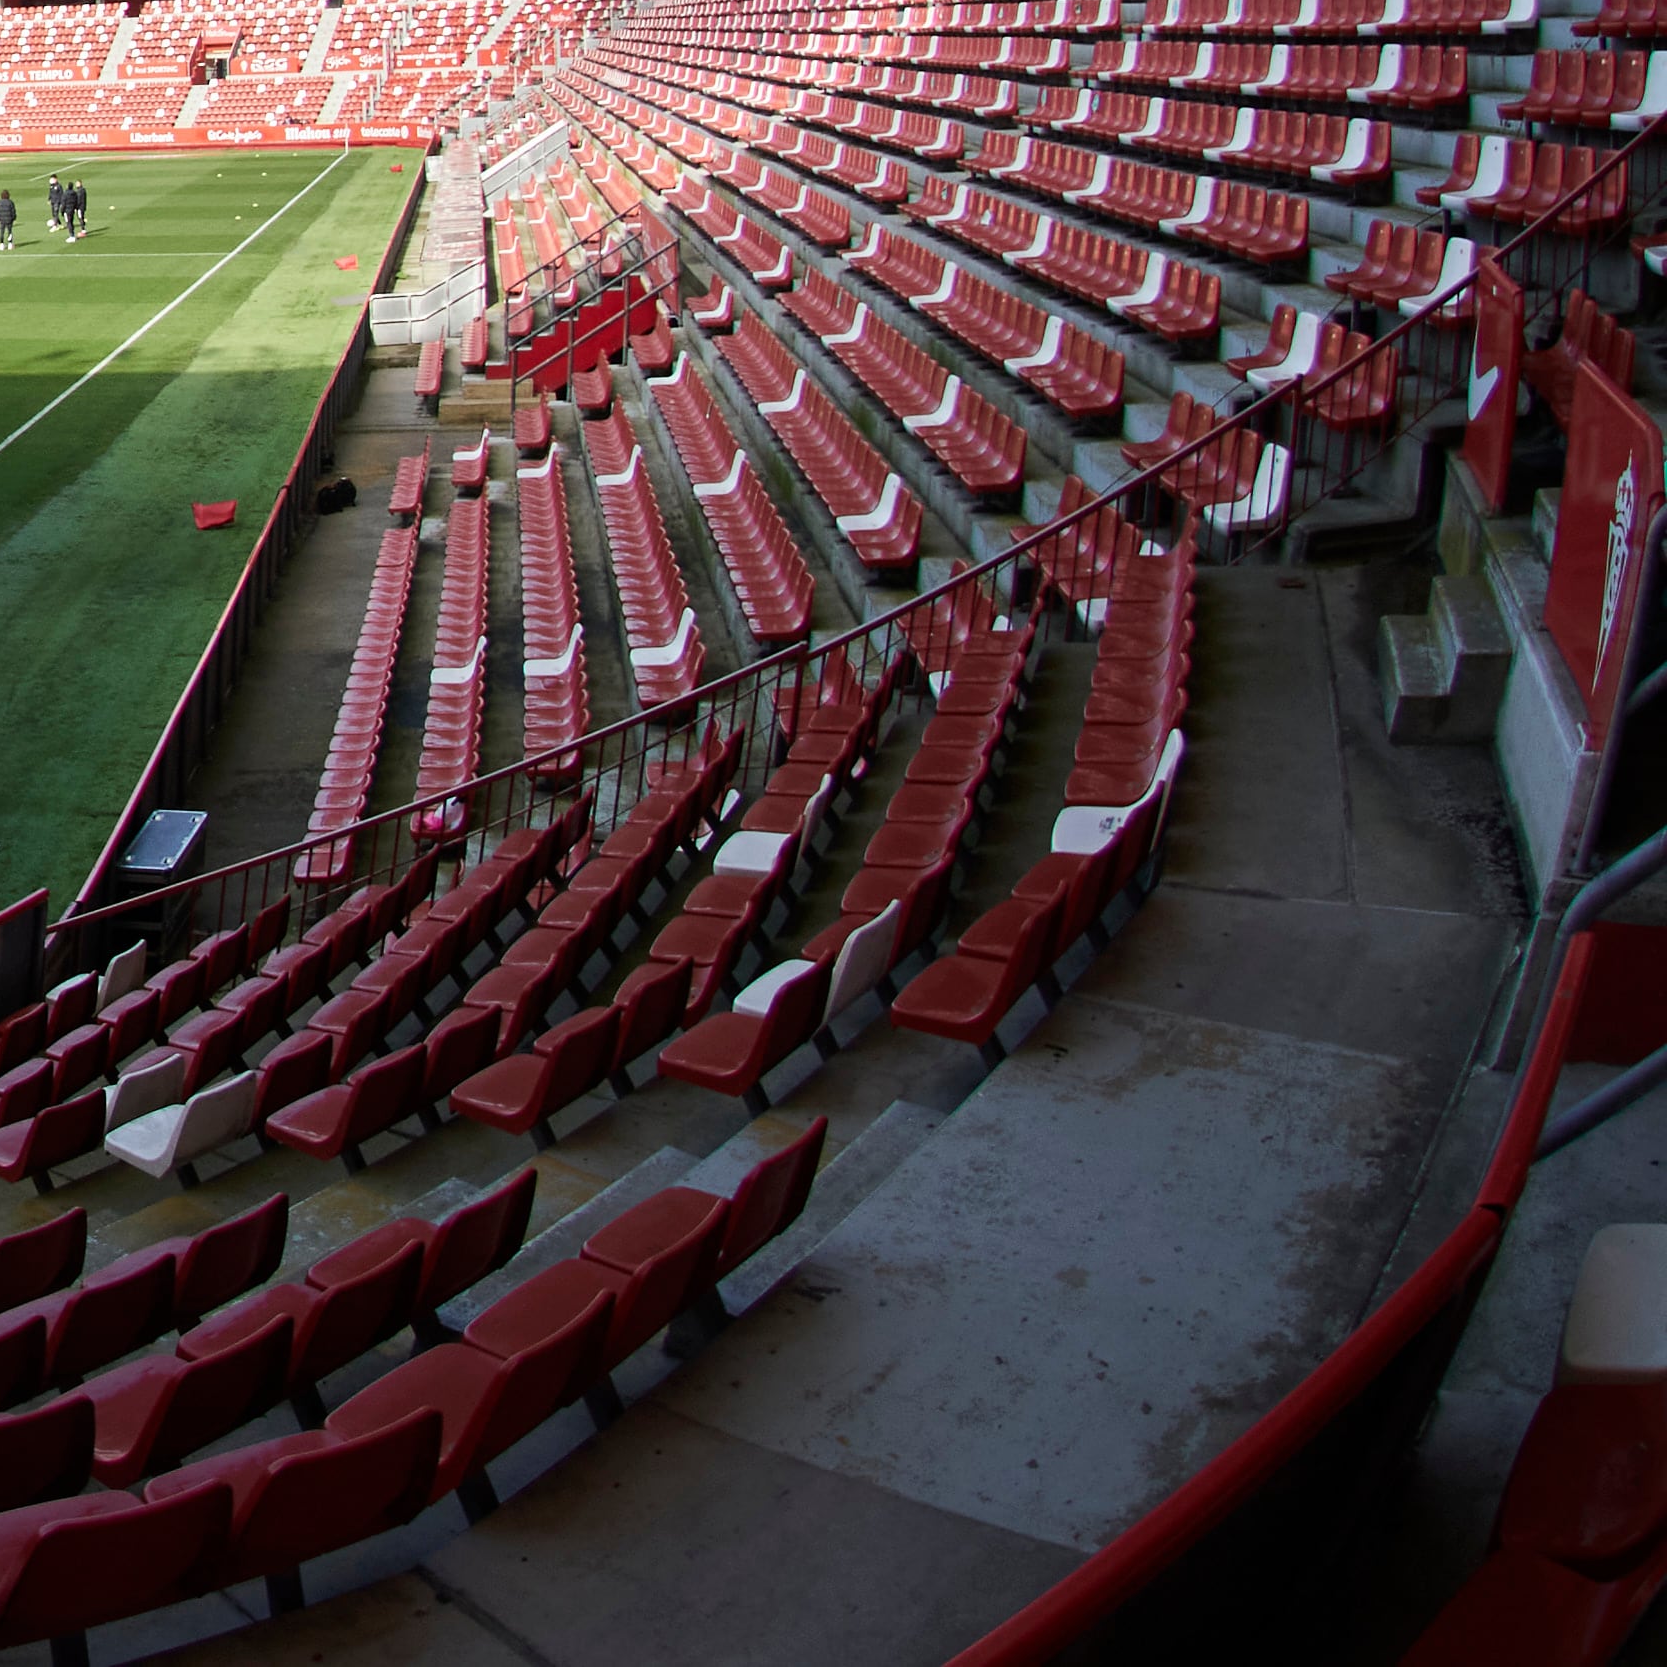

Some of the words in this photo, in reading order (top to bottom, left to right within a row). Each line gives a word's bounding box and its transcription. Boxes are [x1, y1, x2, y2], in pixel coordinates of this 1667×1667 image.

[11, 72, 26, 82] AL
[28, 69, 73, 81] TEMPLO
[45, 133, 97, 144] NISSAN
[130, 133, 174, 143] Liberbank
[285, 127, 329, 140] Mahou
